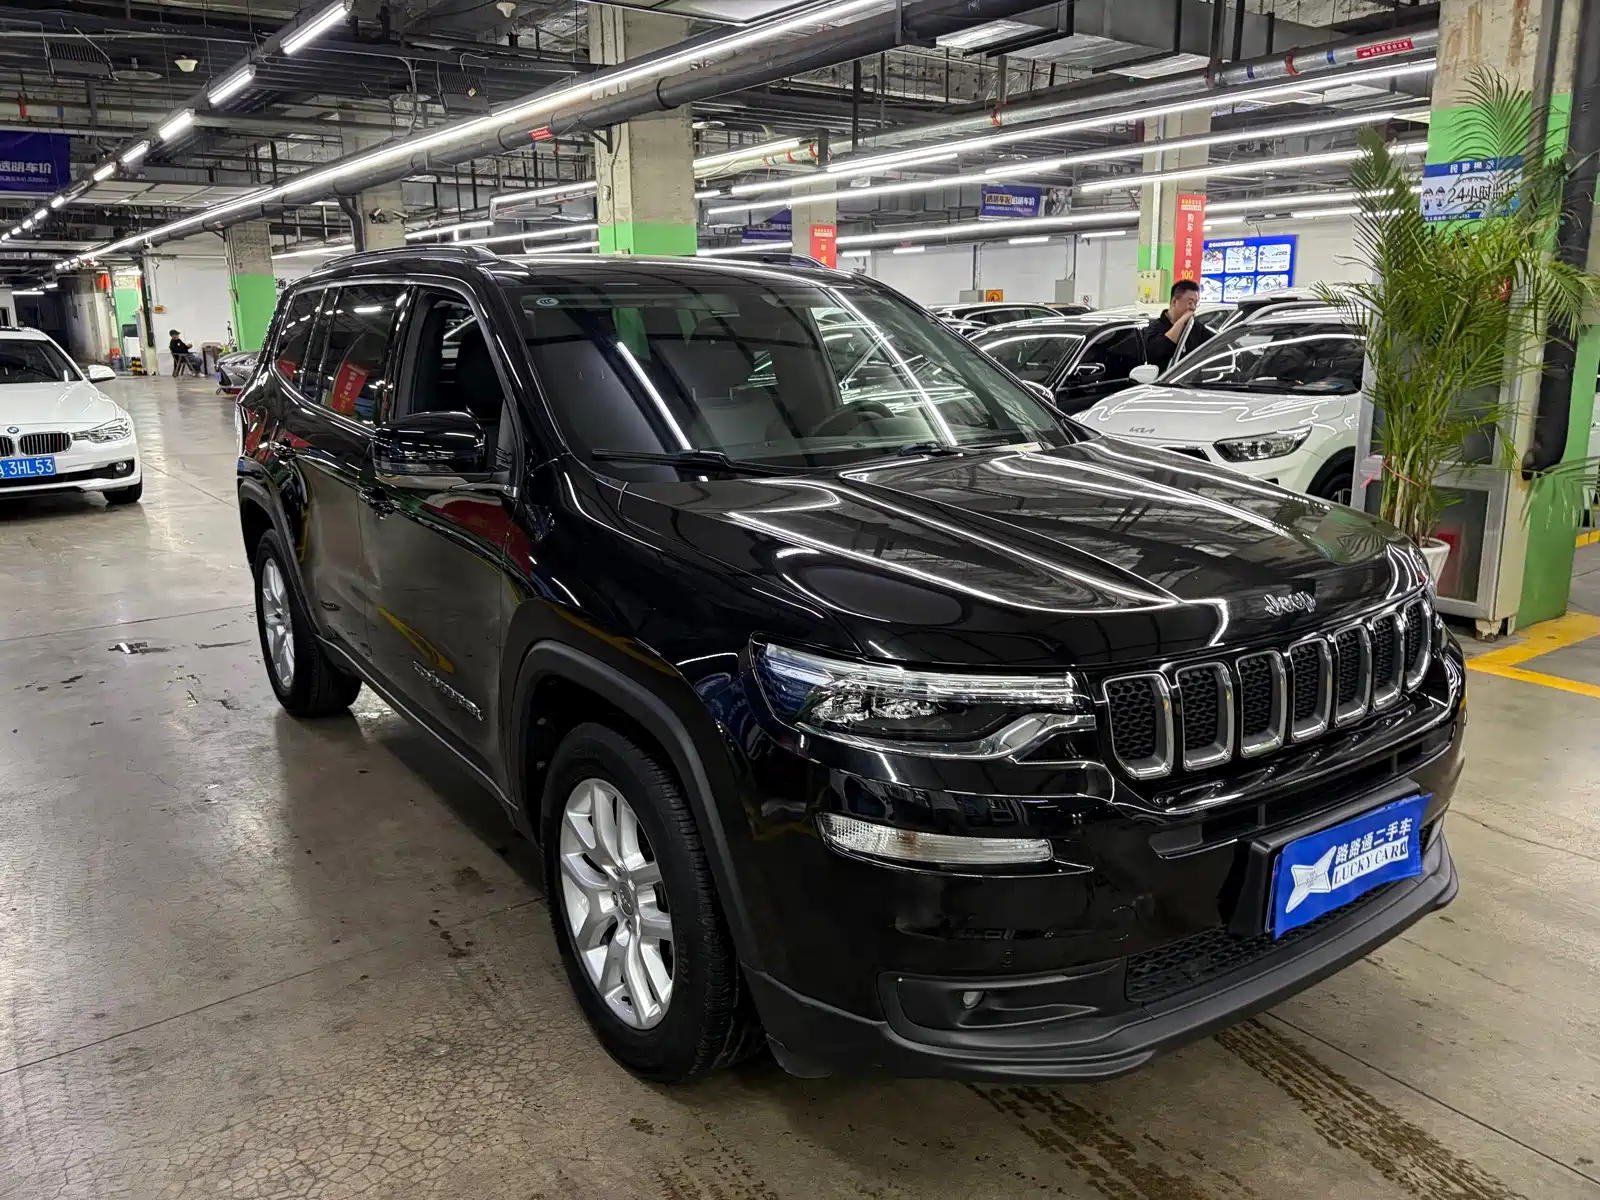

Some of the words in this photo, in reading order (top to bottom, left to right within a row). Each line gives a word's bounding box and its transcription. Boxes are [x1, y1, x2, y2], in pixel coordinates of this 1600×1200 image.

[1264, 591, 1316, 616] Jeep
[1335, 818, 1412, 865] 路路通二手车
[1335, 853, 1373, 884] LUCKY
